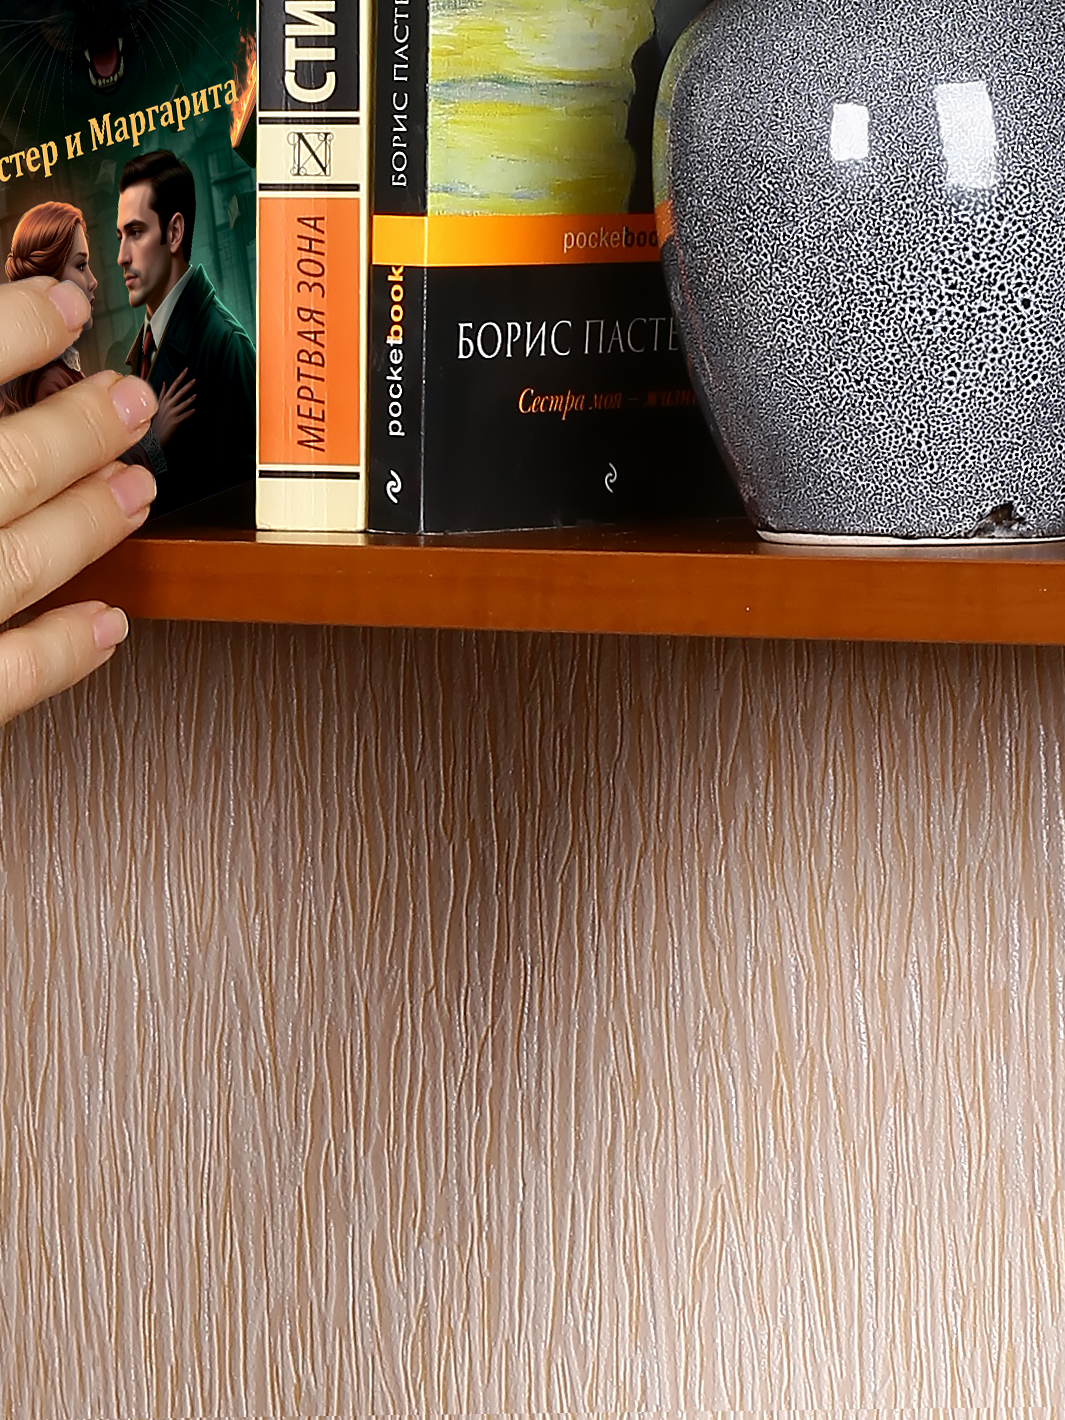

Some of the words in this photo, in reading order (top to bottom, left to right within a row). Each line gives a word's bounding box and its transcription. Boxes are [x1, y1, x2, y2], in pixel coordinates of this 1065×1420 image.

[65, 131, 85, 160] и
[87, 79, 239, 151] Маргарита
[391, 92, 409, 187] БОРИС
[296, 215, 326, 299] ЗОНА
[563, 226, 659, 254] pocketboo
[385, 264, 406, 437] pocketbook
[457, 320, 573, 359] БОРИС
[584, 316, 680, 355] ПАСТЕ
[296, 307, 326, 453] МЕРТВАЯ
[518, 387, 585, 421] Сестра
[588, 391, 623, 411] моя
